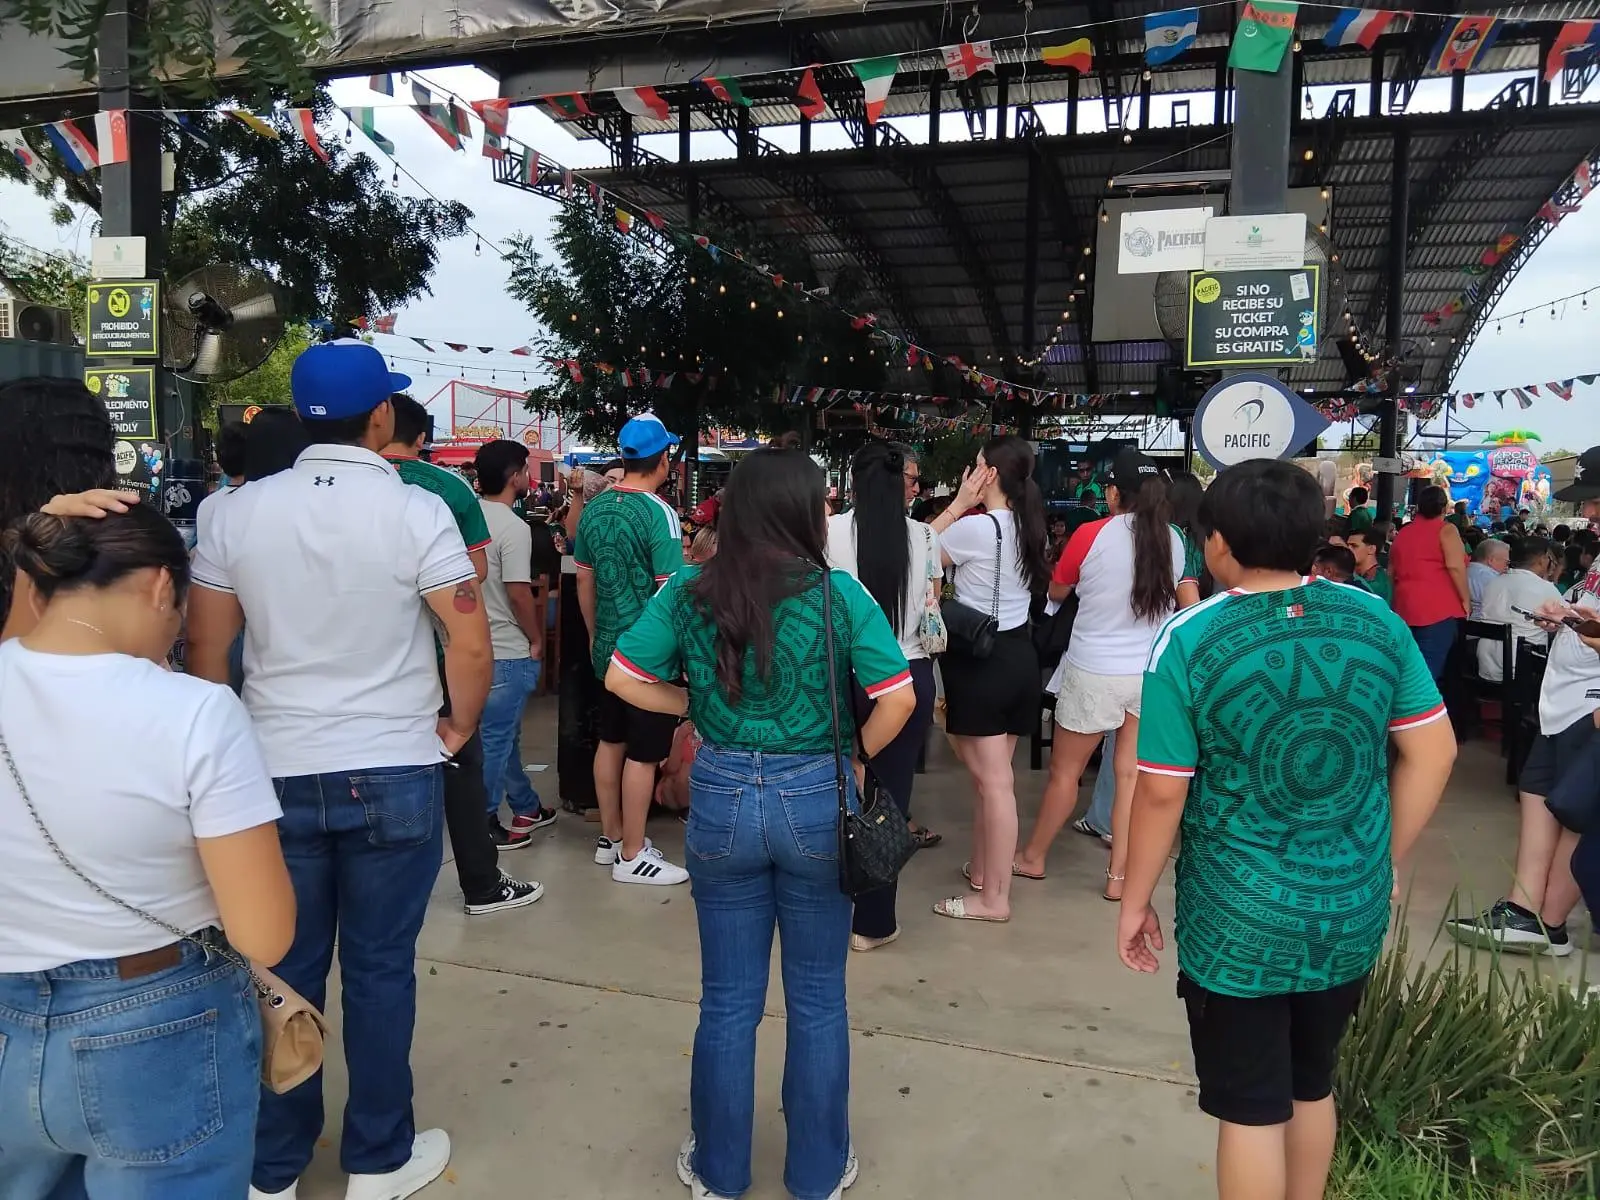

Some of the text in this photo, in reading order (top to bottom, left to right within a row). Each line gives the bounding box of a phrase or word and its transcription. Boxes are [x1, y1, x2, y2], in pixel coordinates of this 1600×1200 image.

[1236, 284, 1270, 296] SI NO
[1222, 297, 1284, 310] RECIBE SU
[1231, 312, 1274, 323] TICKET
[101, 322, 139, 331] PROHIBIDO
[1215, 326, 1289, 338] SU COMPRA
[1216, 340, 1284, 354] ES GRATIS
[109, 411, 125, 421] PET
[1224, 433, 1271, 448] PACIFIC
[116, 450, 135, 460] ACIFIC
[127, 479, 151, 489] Eventos
